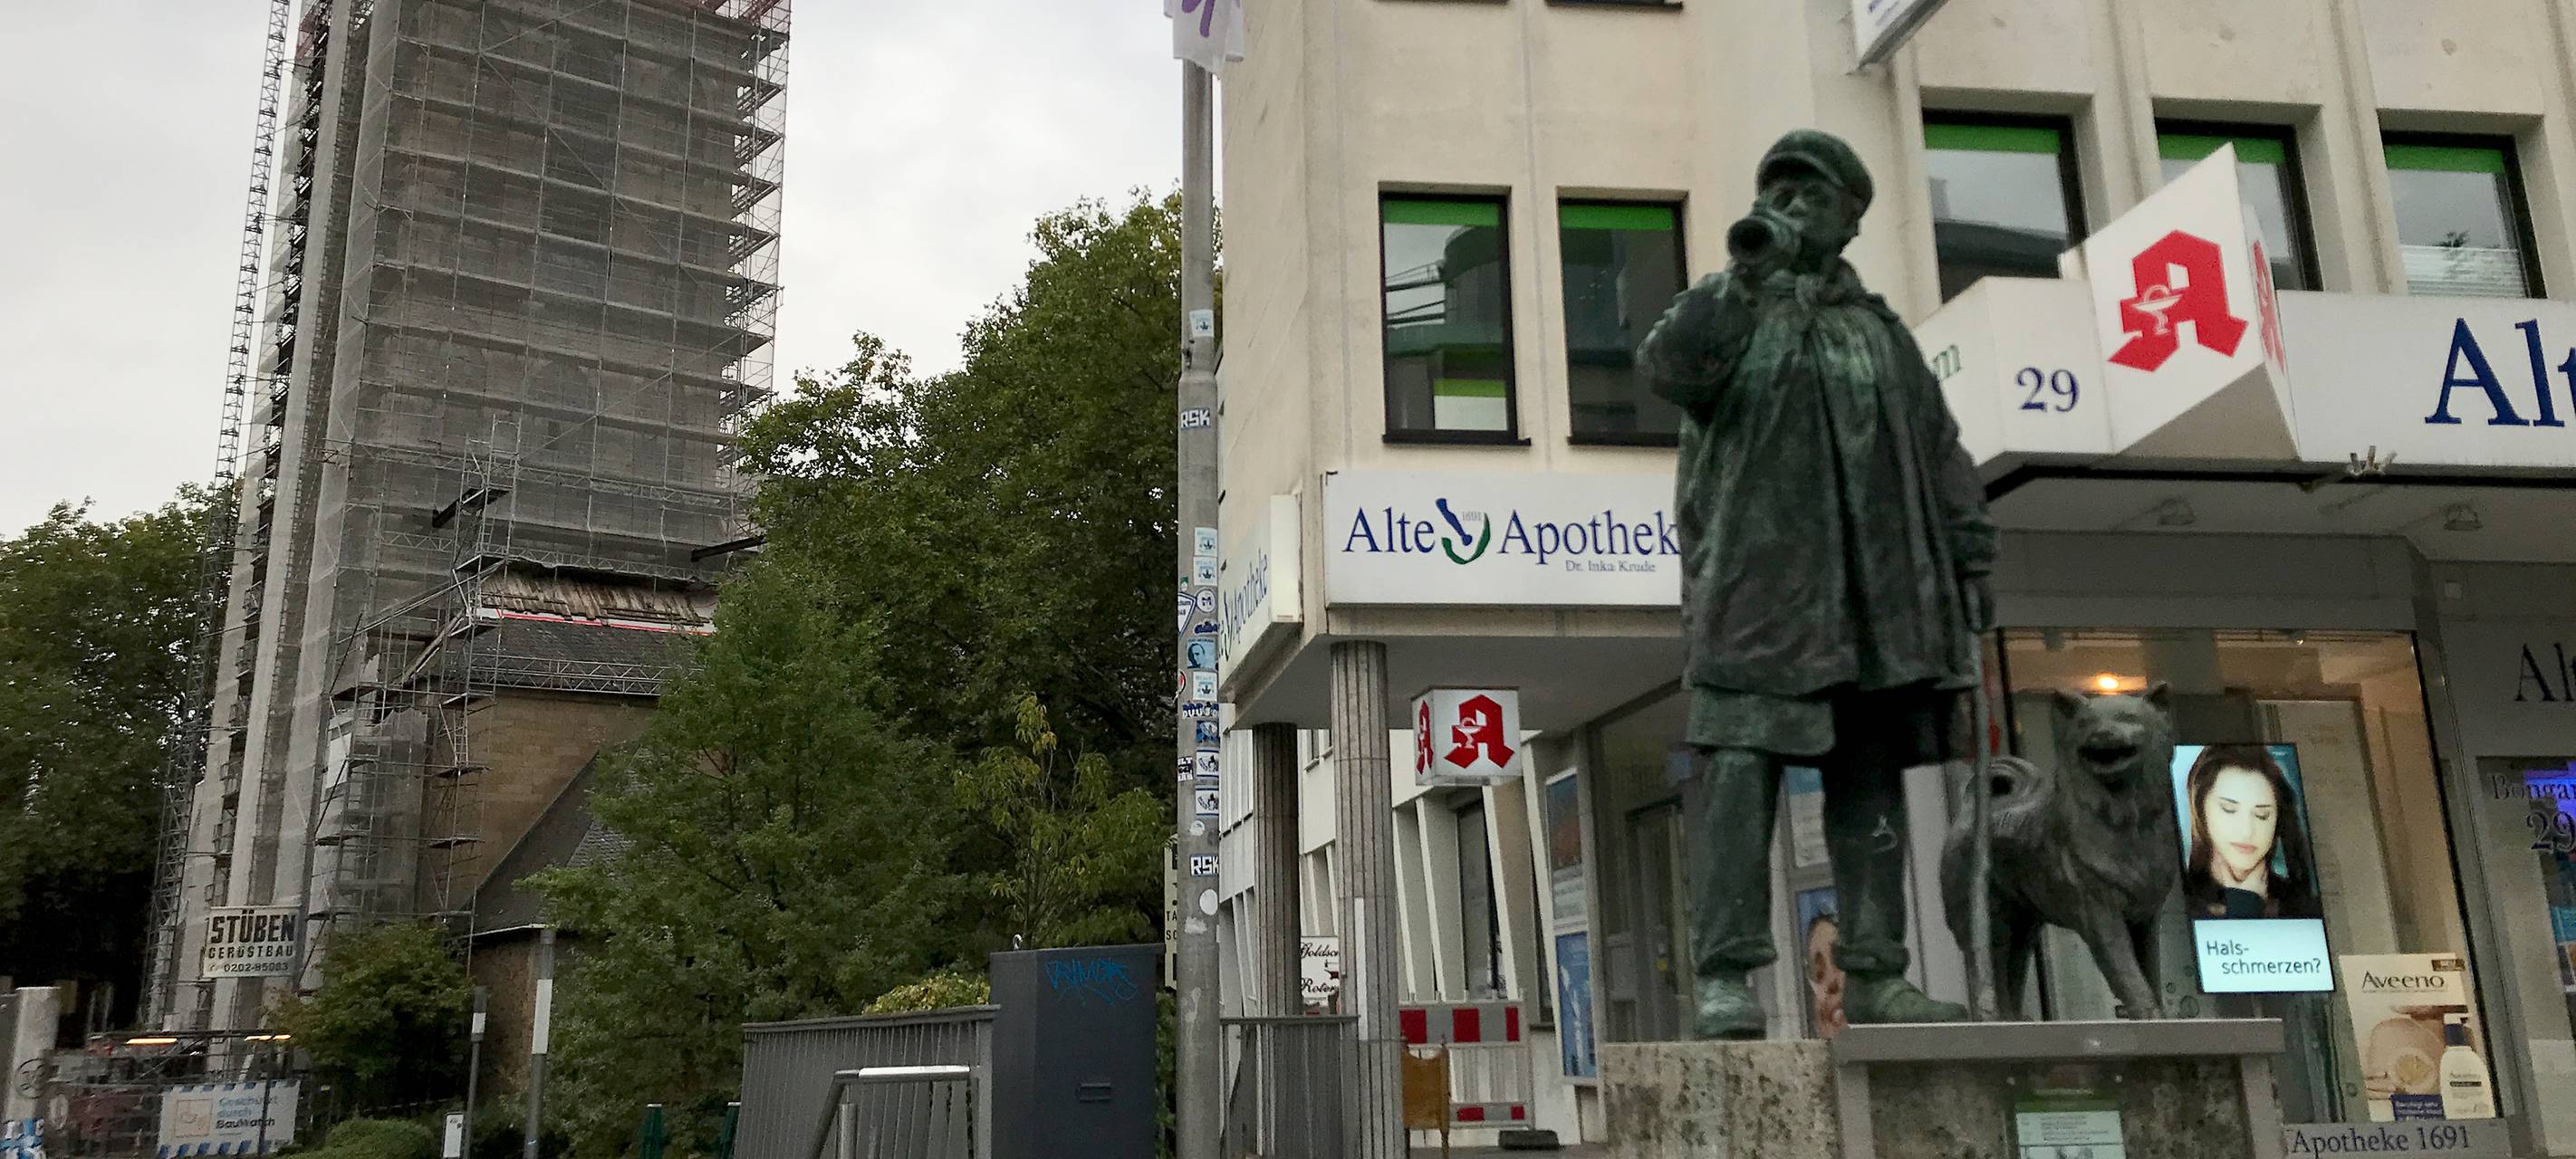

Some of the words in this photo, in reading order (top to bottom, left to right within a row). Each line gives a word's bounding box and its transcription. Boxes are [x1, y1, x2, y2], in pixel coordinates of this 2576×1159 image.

[2016, 367, 2081, 413] 29
[1342, 506, 1435, 553] Alte
[1497, 508, 1681, 565] Apothek
[1565, 560, 1583, 572] Dr.
[1588, 560, 1614, 572] Inka
[2515, 642, 2576, 703] Al
[210, 908, 297, 943] STÜBEN
[208, 944, 293, 960] GERÜSTBAU
[2206, 940, 2250, 956] Hals-
[2222, 957, 2321, 975] schmerzen?
[2362, 971, 2445, 990] Aveeno
[2291, 1125, 2409, 1159] Apotheke
[2417, 1125, 2470, 1151] 1691
